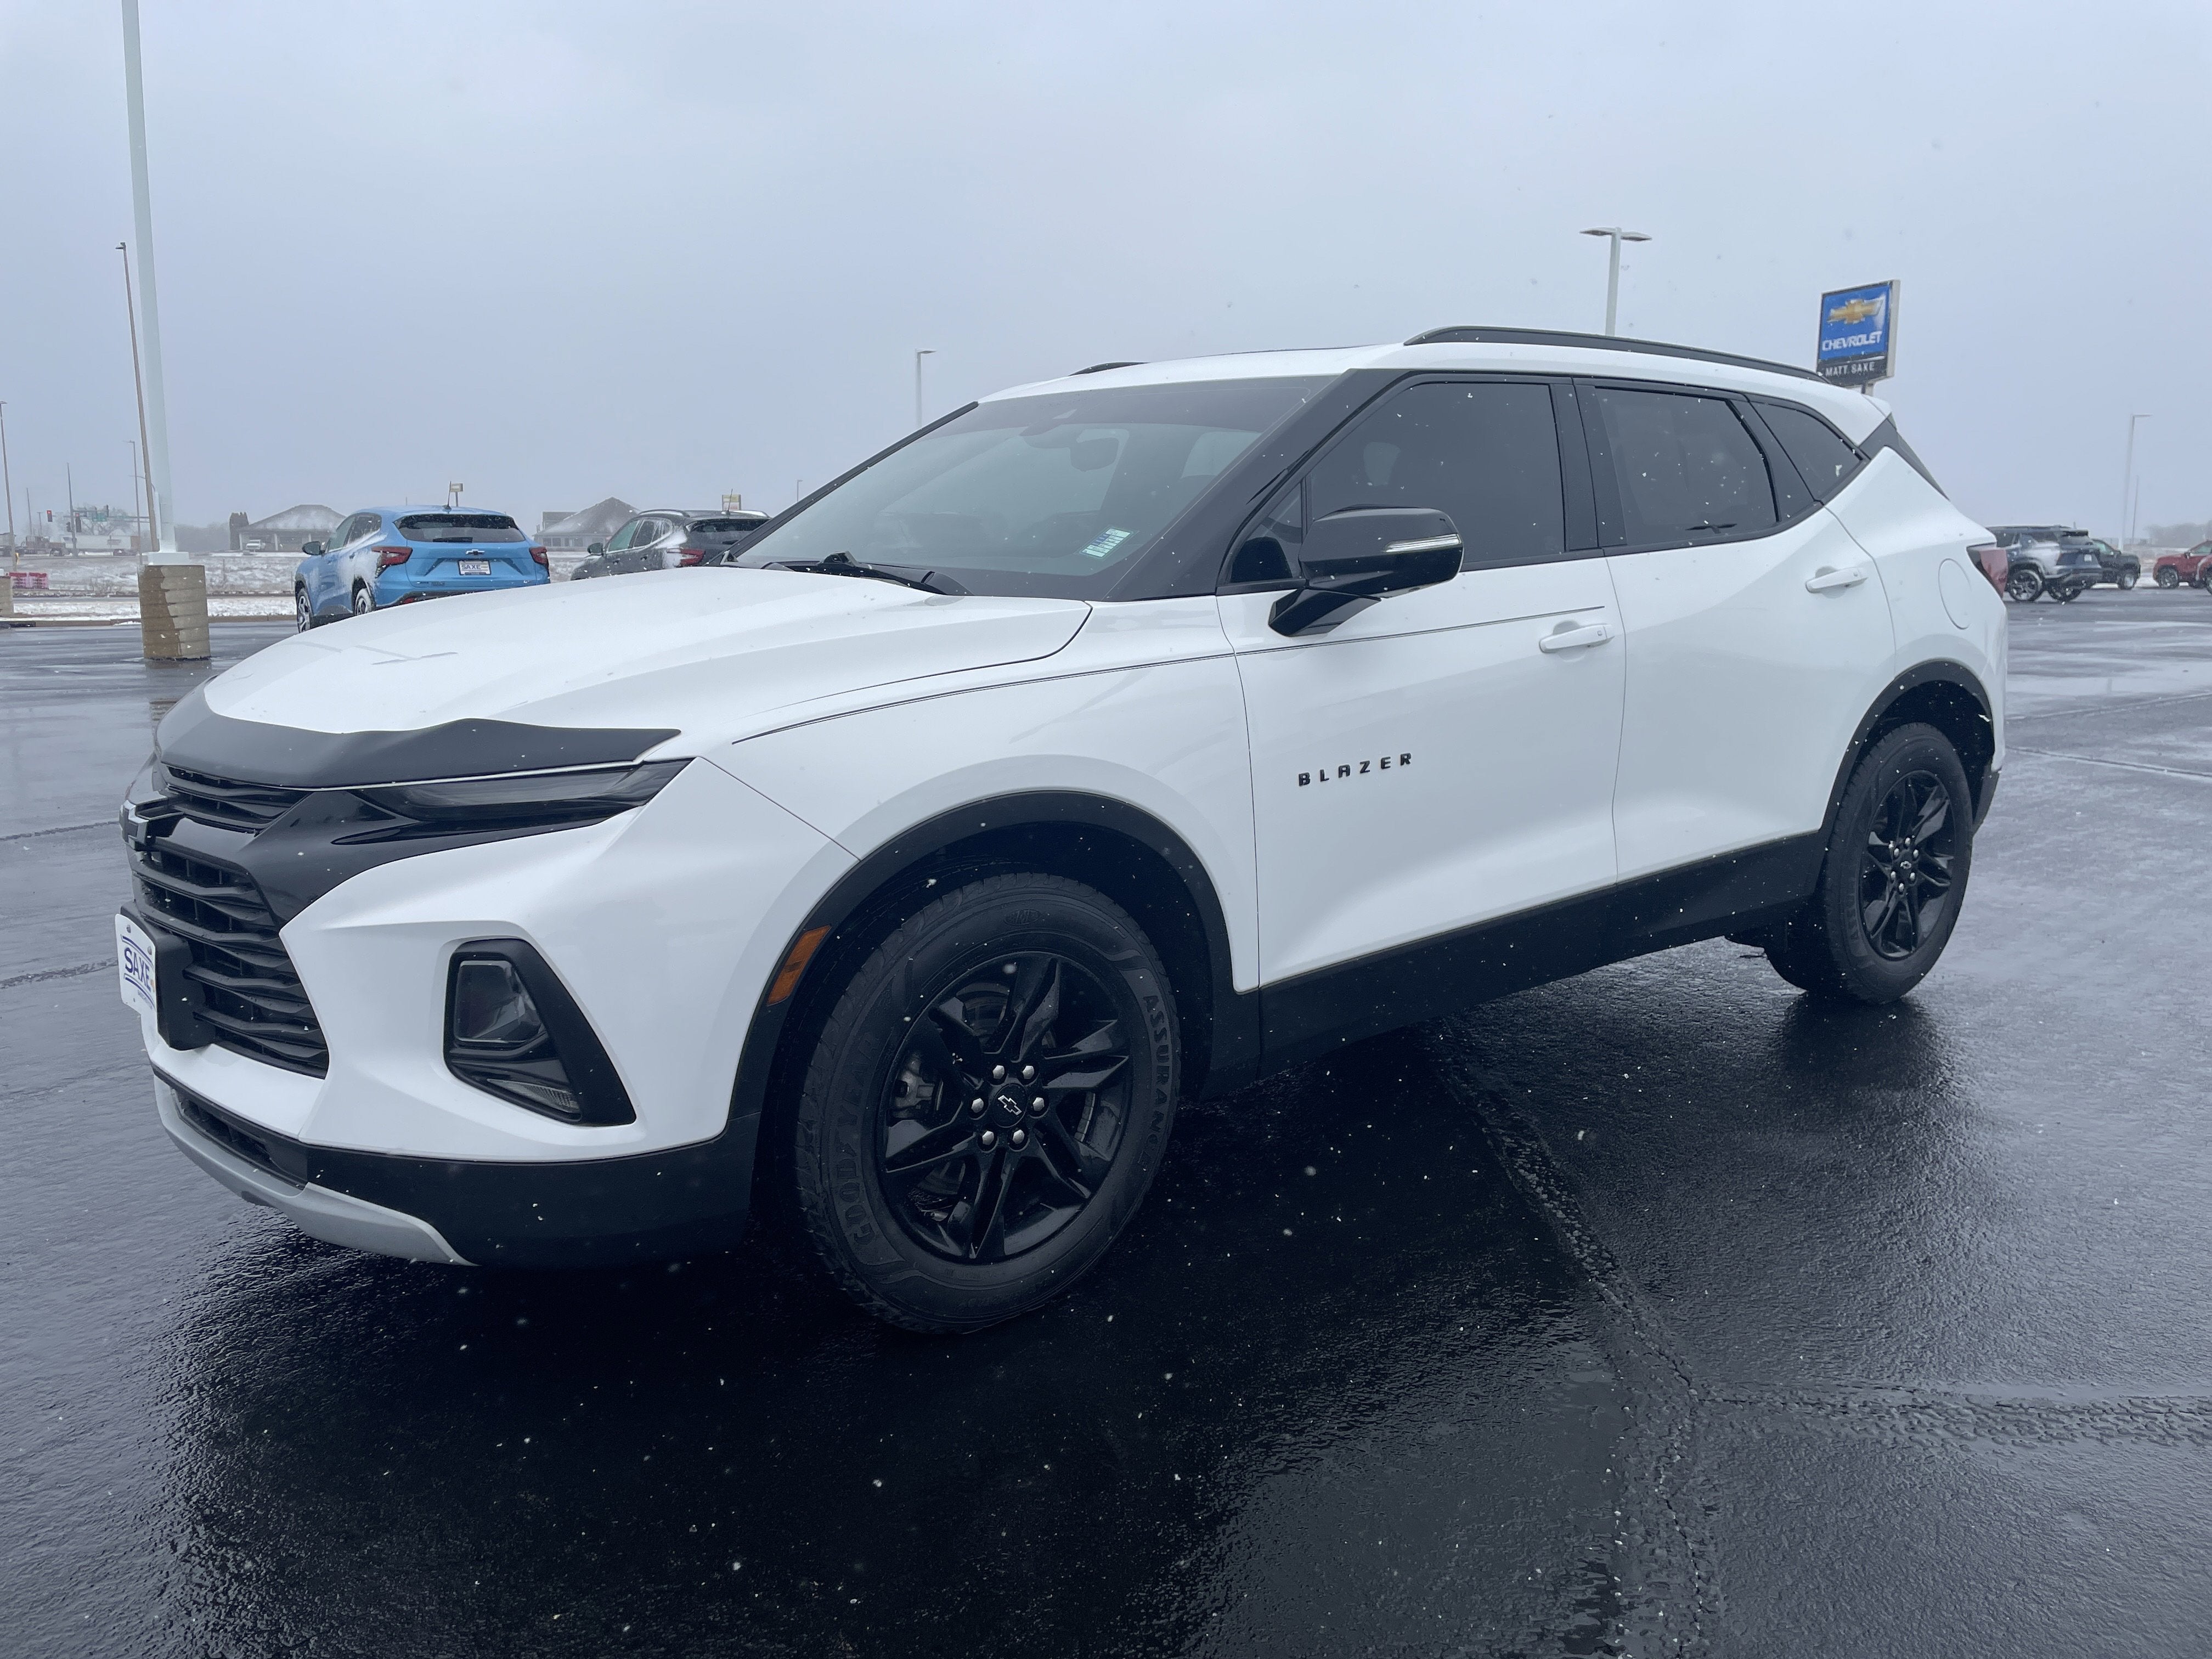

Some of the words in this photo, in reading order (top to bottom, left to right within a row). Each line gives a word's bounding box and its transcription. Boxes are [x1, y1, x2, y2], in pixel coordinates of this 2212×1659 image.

[1821, 331, 1883, 352] CHEVROLET
[1825, 364, 1848, 377] MATT
[1851, 361, 1875, 374] SAXE
[1298, 753, 1412, 787] BLAZER
[124, 947, 151, 993] SAXE
[1138, 994, 1170, 1170] ASSURANCE
